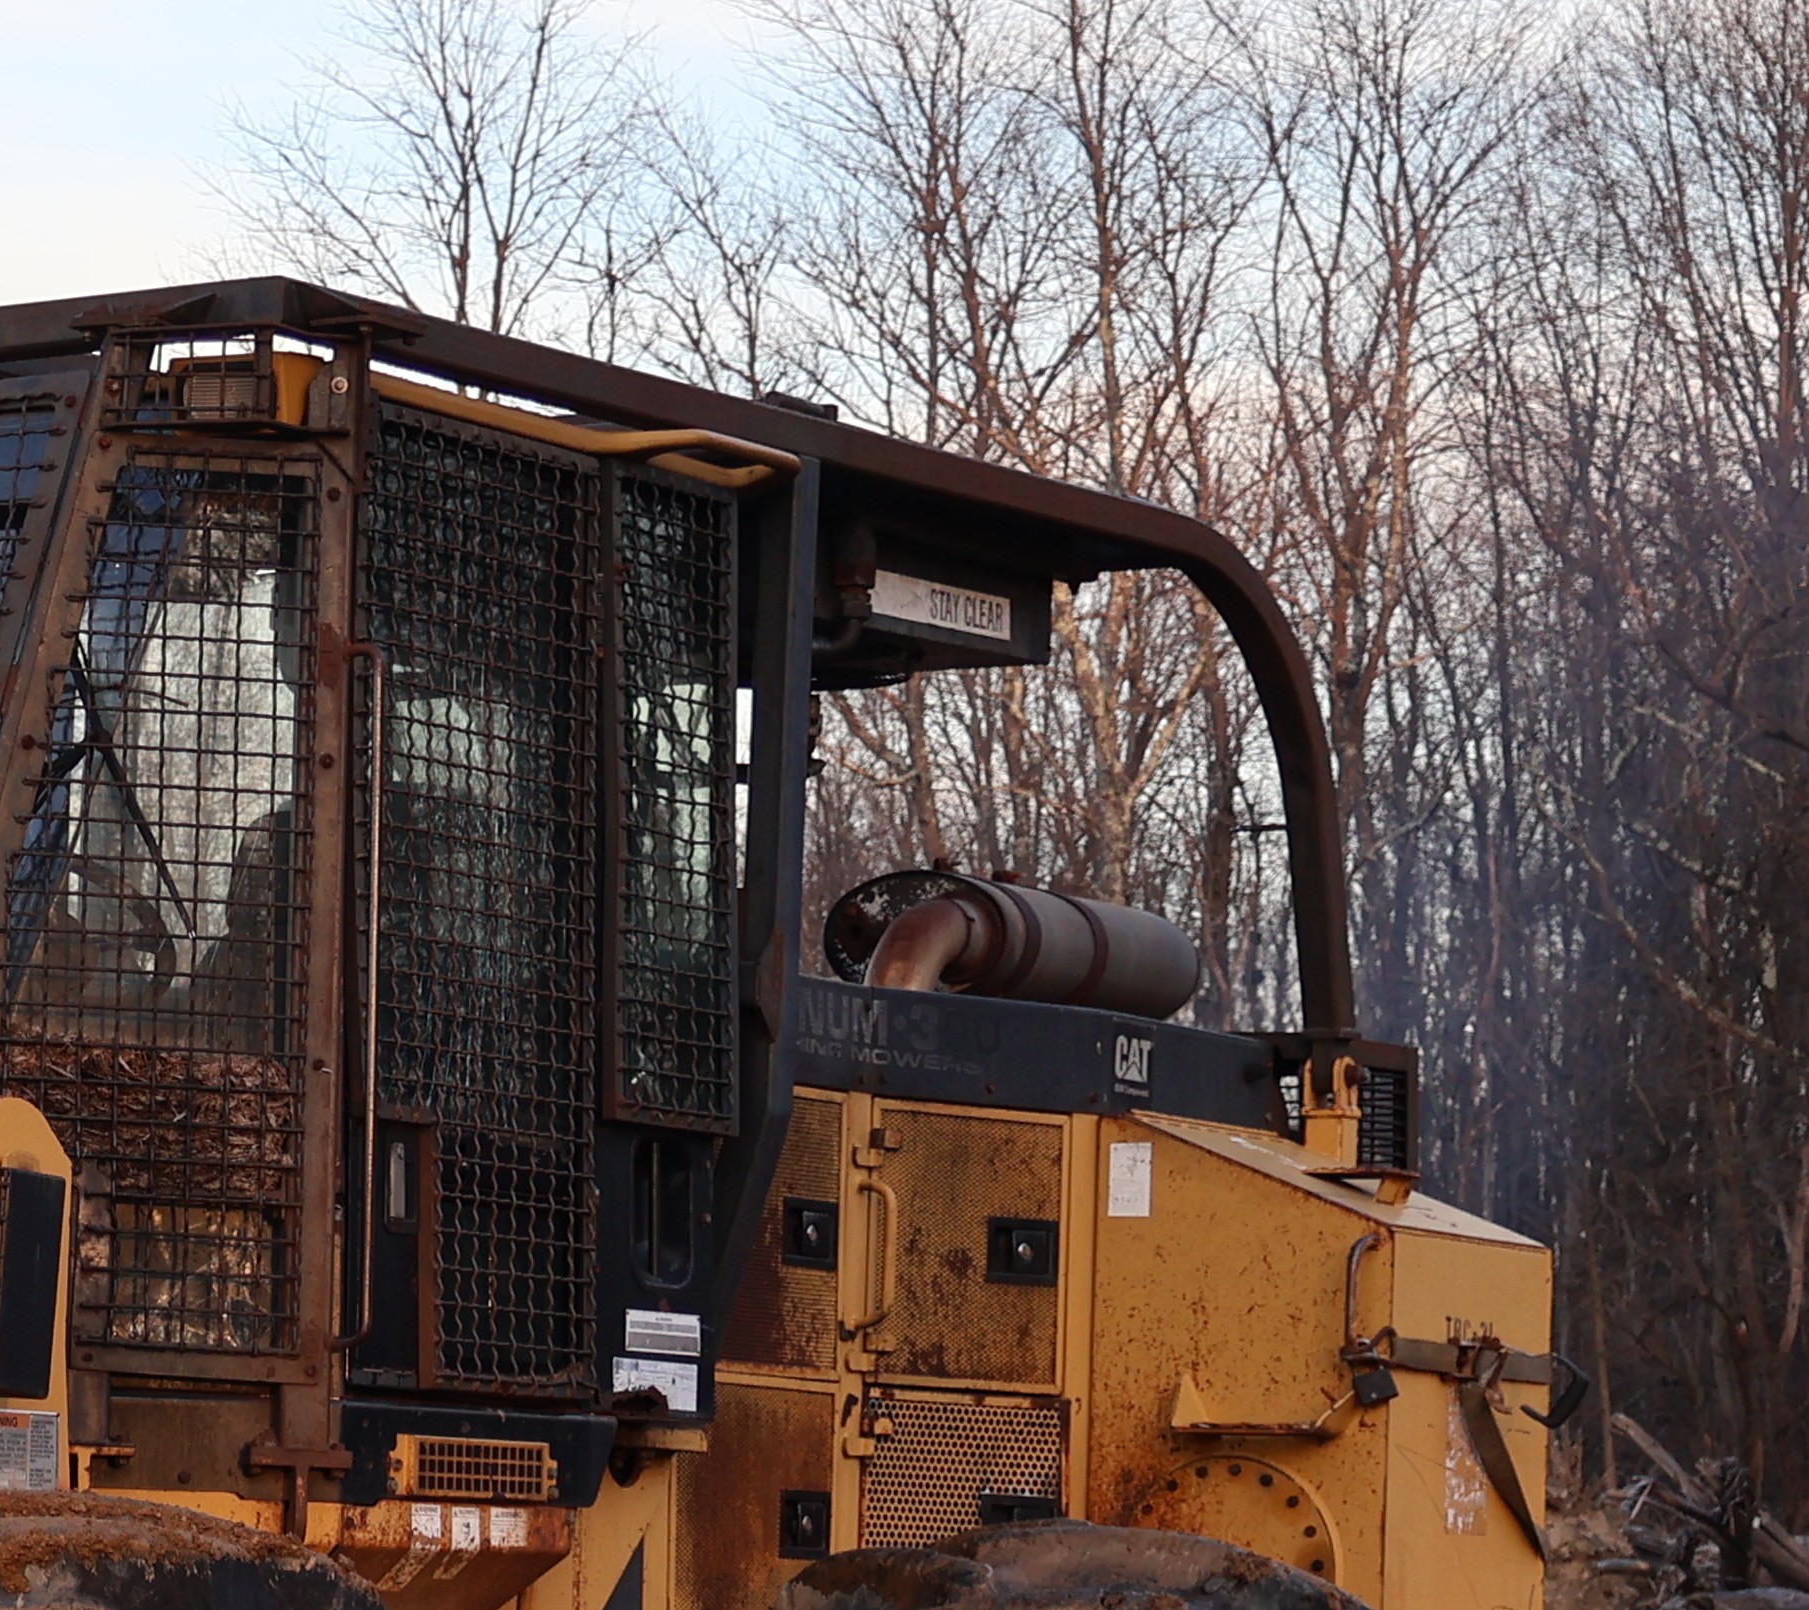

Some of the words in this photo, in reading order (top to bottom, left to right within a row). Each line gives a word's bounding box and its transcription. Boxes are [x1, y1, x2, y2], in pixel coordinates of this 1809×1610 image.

[929, 588, 960, 623] STAY
[964, 596, 1003, 632] CLEAR
[1114, 1034, 1152, 1083] CAT
